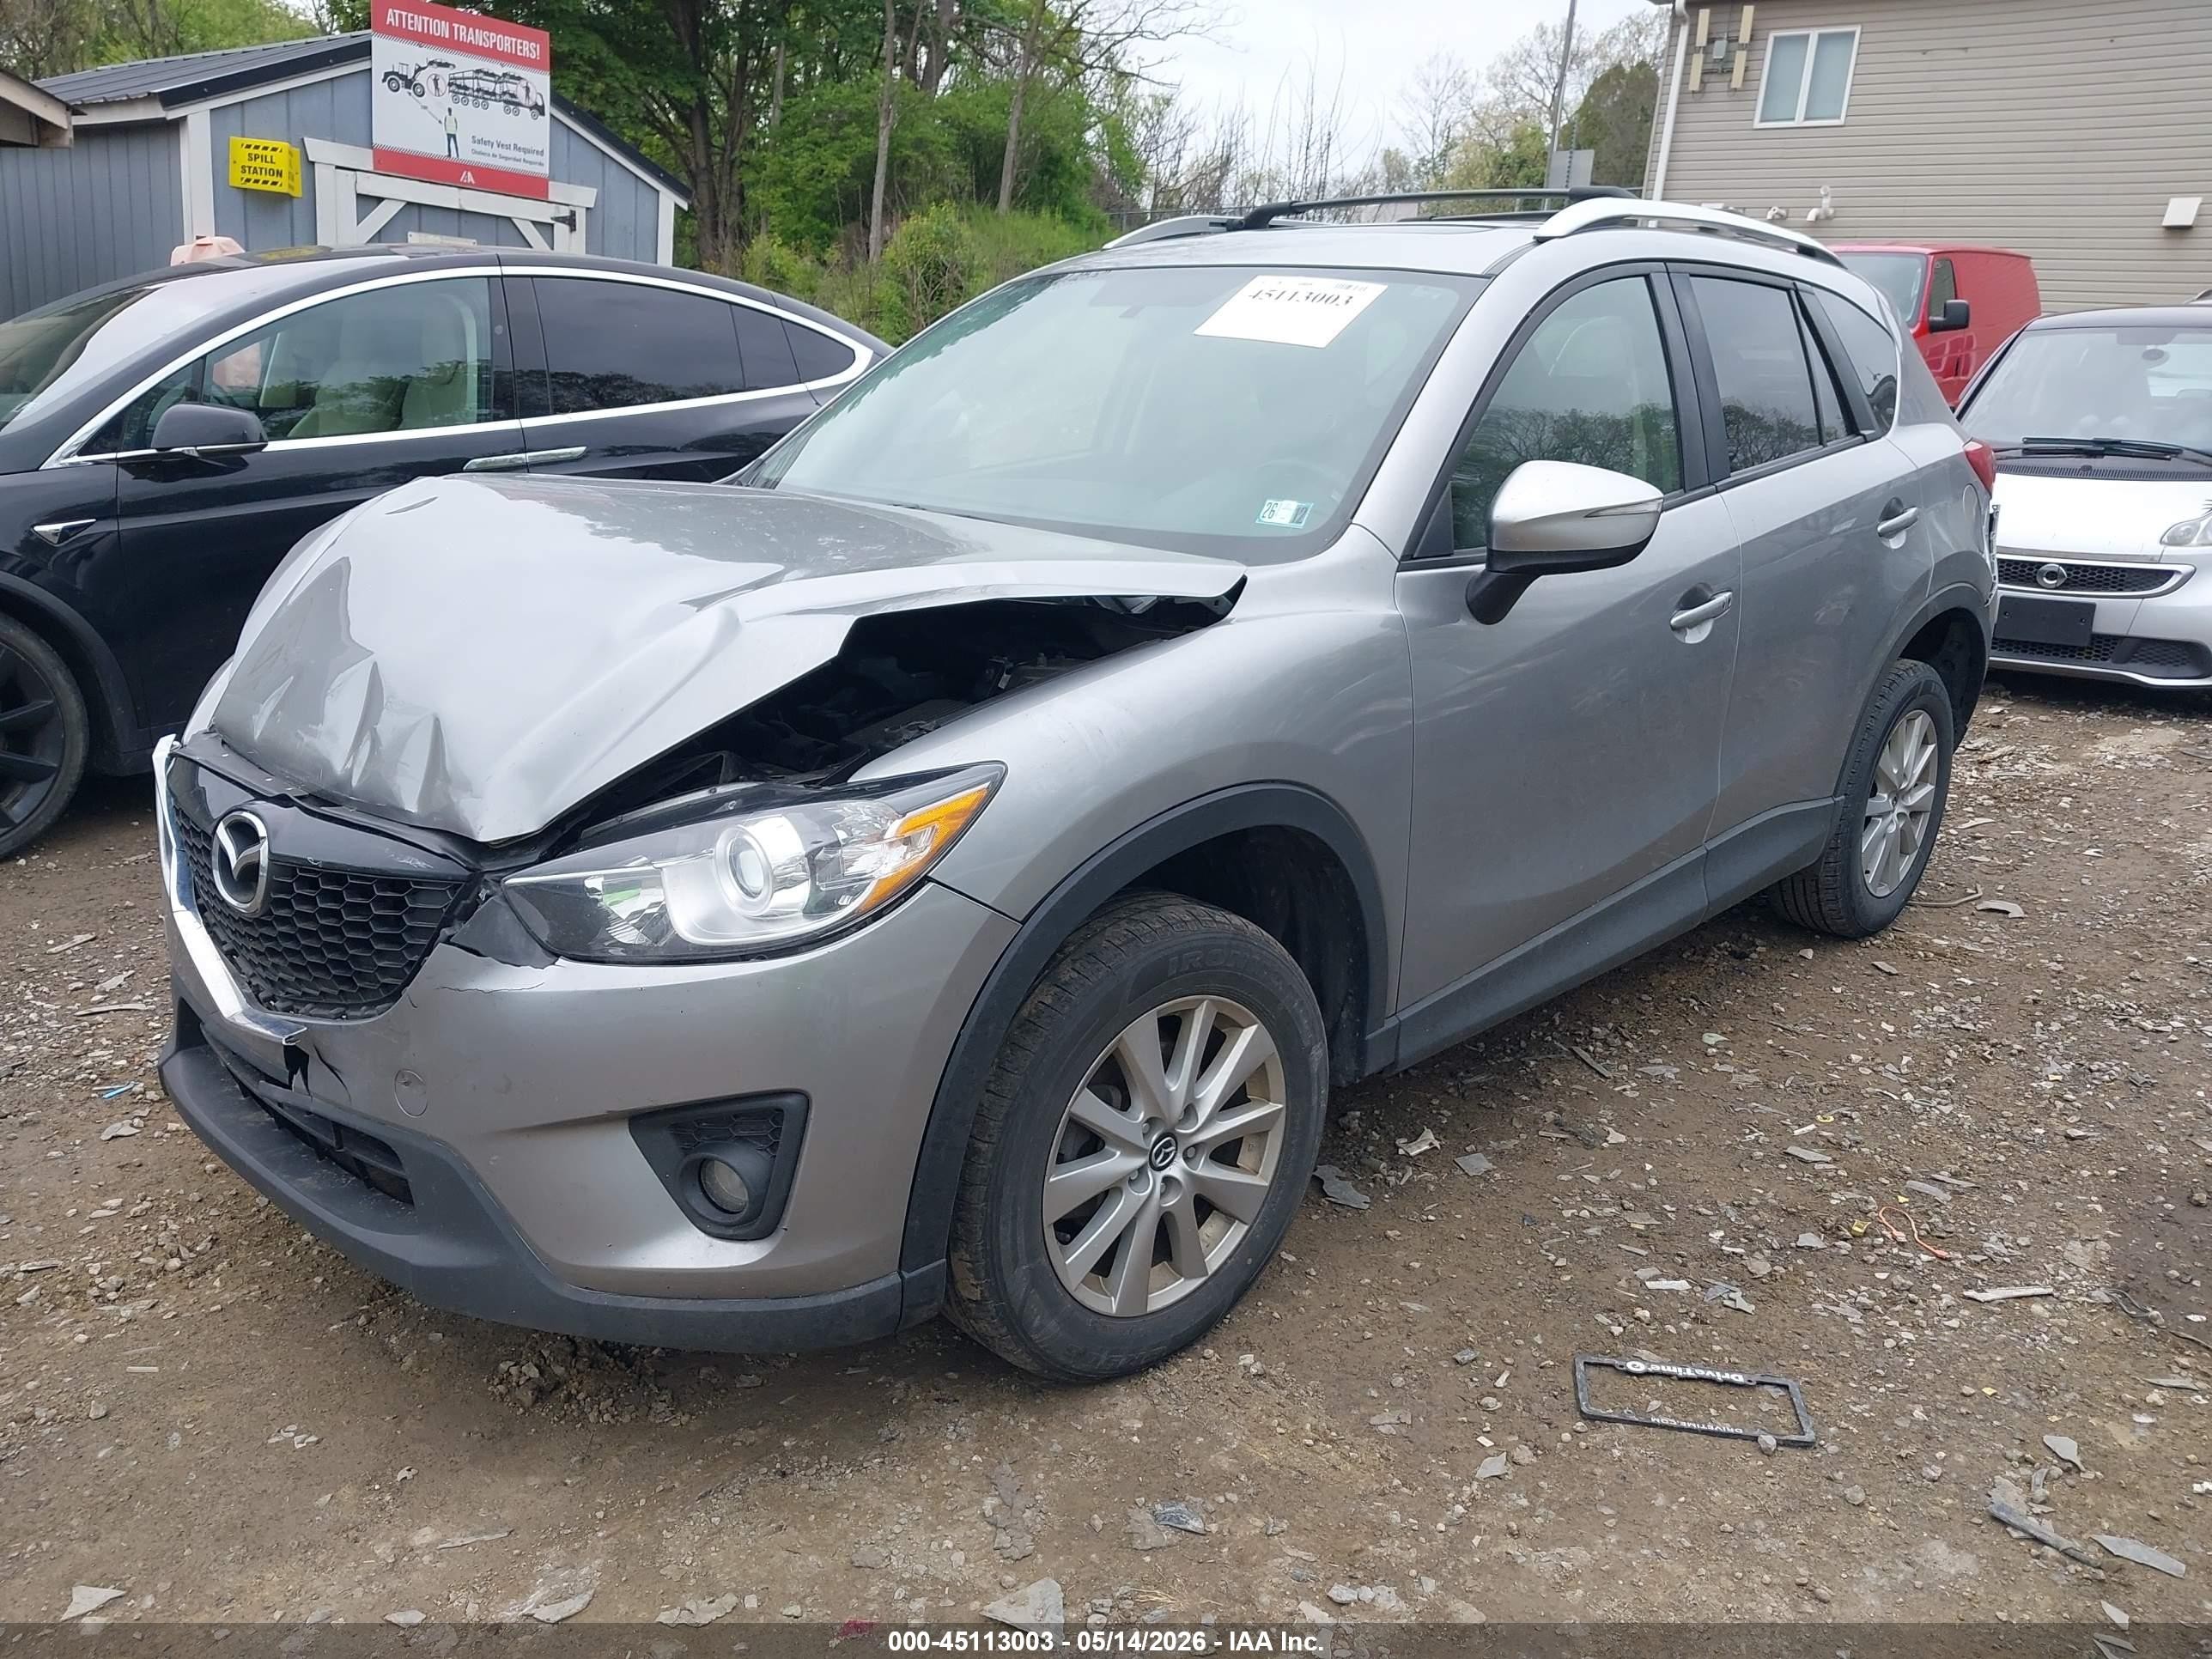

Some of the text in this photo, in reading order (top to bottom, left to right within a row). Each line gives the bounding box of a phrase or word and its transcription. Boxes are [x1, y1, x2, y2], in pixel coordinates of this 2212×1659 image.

[386, 8, 541, 60] ATTENTION TRANSPORTERS!
[471, 135, 544, 156] Safety Vest Required
[247, 152, 276, 164] SPILL
[240, 164, 283, 179] STATION
[1261, 501, 1278, 519] 26
[1650, 1364, 1744, 1382] DriveTime
[1650, 1417, 1743, 1434] DRIVETIME.COM
